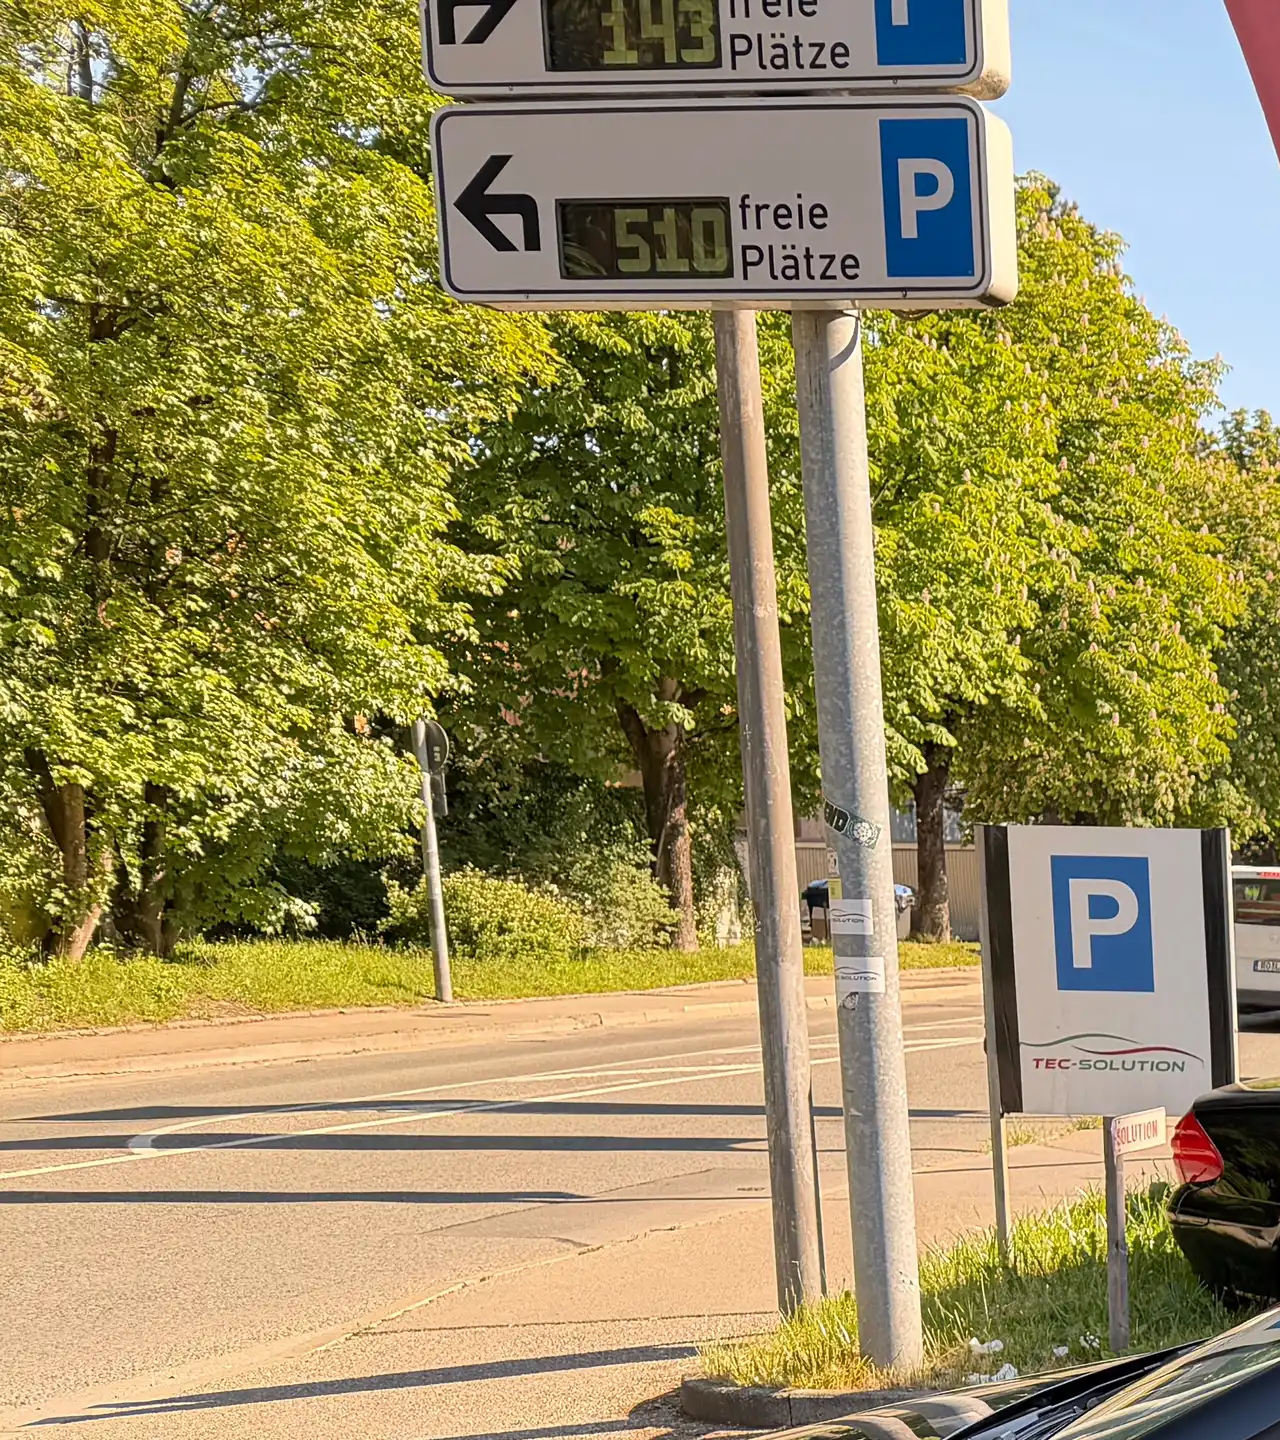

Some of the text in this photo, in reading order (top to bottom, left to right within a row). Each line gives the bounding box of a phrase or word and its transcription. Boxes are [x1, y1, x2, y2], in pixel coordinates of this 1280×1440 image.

[602, 0, 715, 64] 143
[729, 32, 850, 70] Plätze
[739, 193, 829, 231] freie
[897, 157, 955, 239] P
[613, 207, 728, 273] 510
[740, 244, 861, 281] Plätze
[1068, 878, 1139, 969] P
[1032, 1058, 1186, 1072] TEC-SOLUTION
